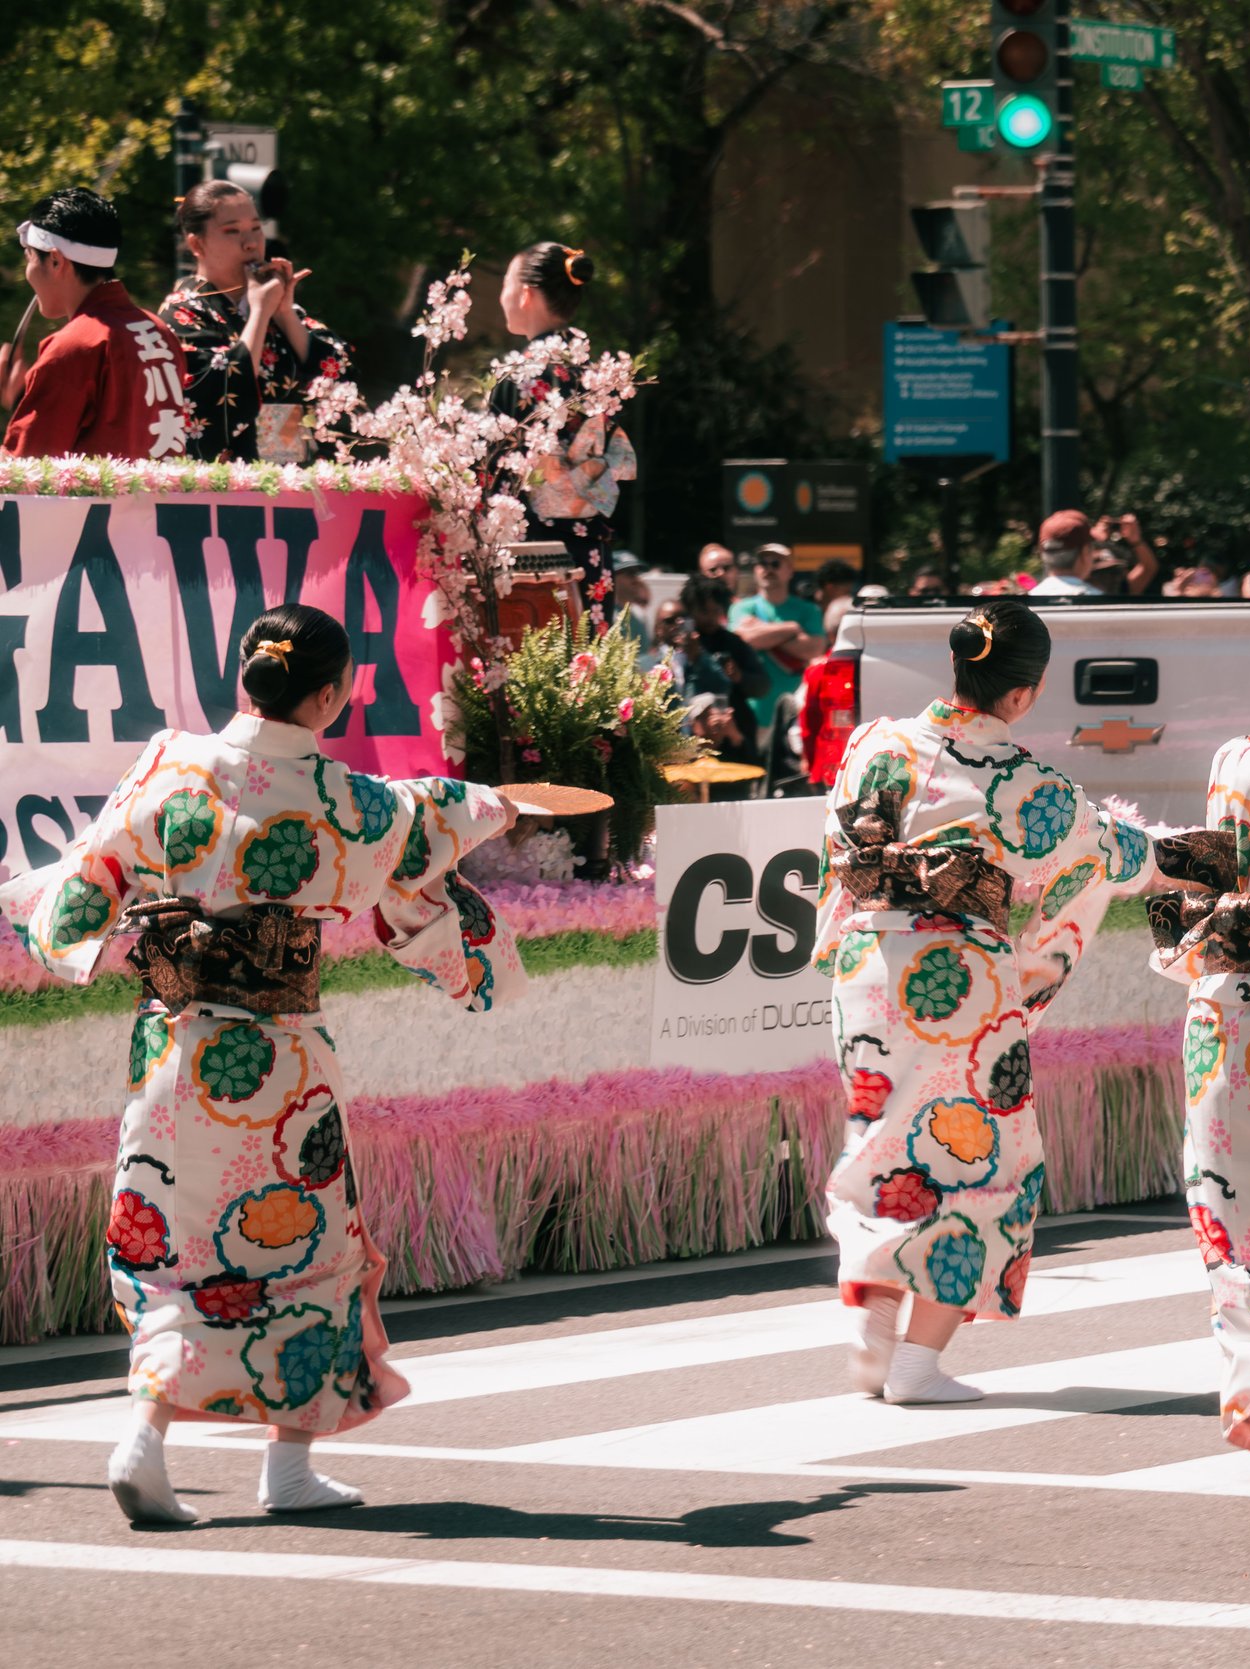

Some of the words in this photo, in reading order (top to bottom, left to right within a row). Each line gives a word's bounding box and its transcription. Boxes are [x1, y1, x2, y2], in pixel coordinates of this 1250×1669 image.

[949, 89, 982, 122] 12
[125, 319, 188, 462] 玉川大
[659, 1017, 672, 1039] A
[677, 1013, 737, 1038] Division
[741, 1008, 757, 1033] of
